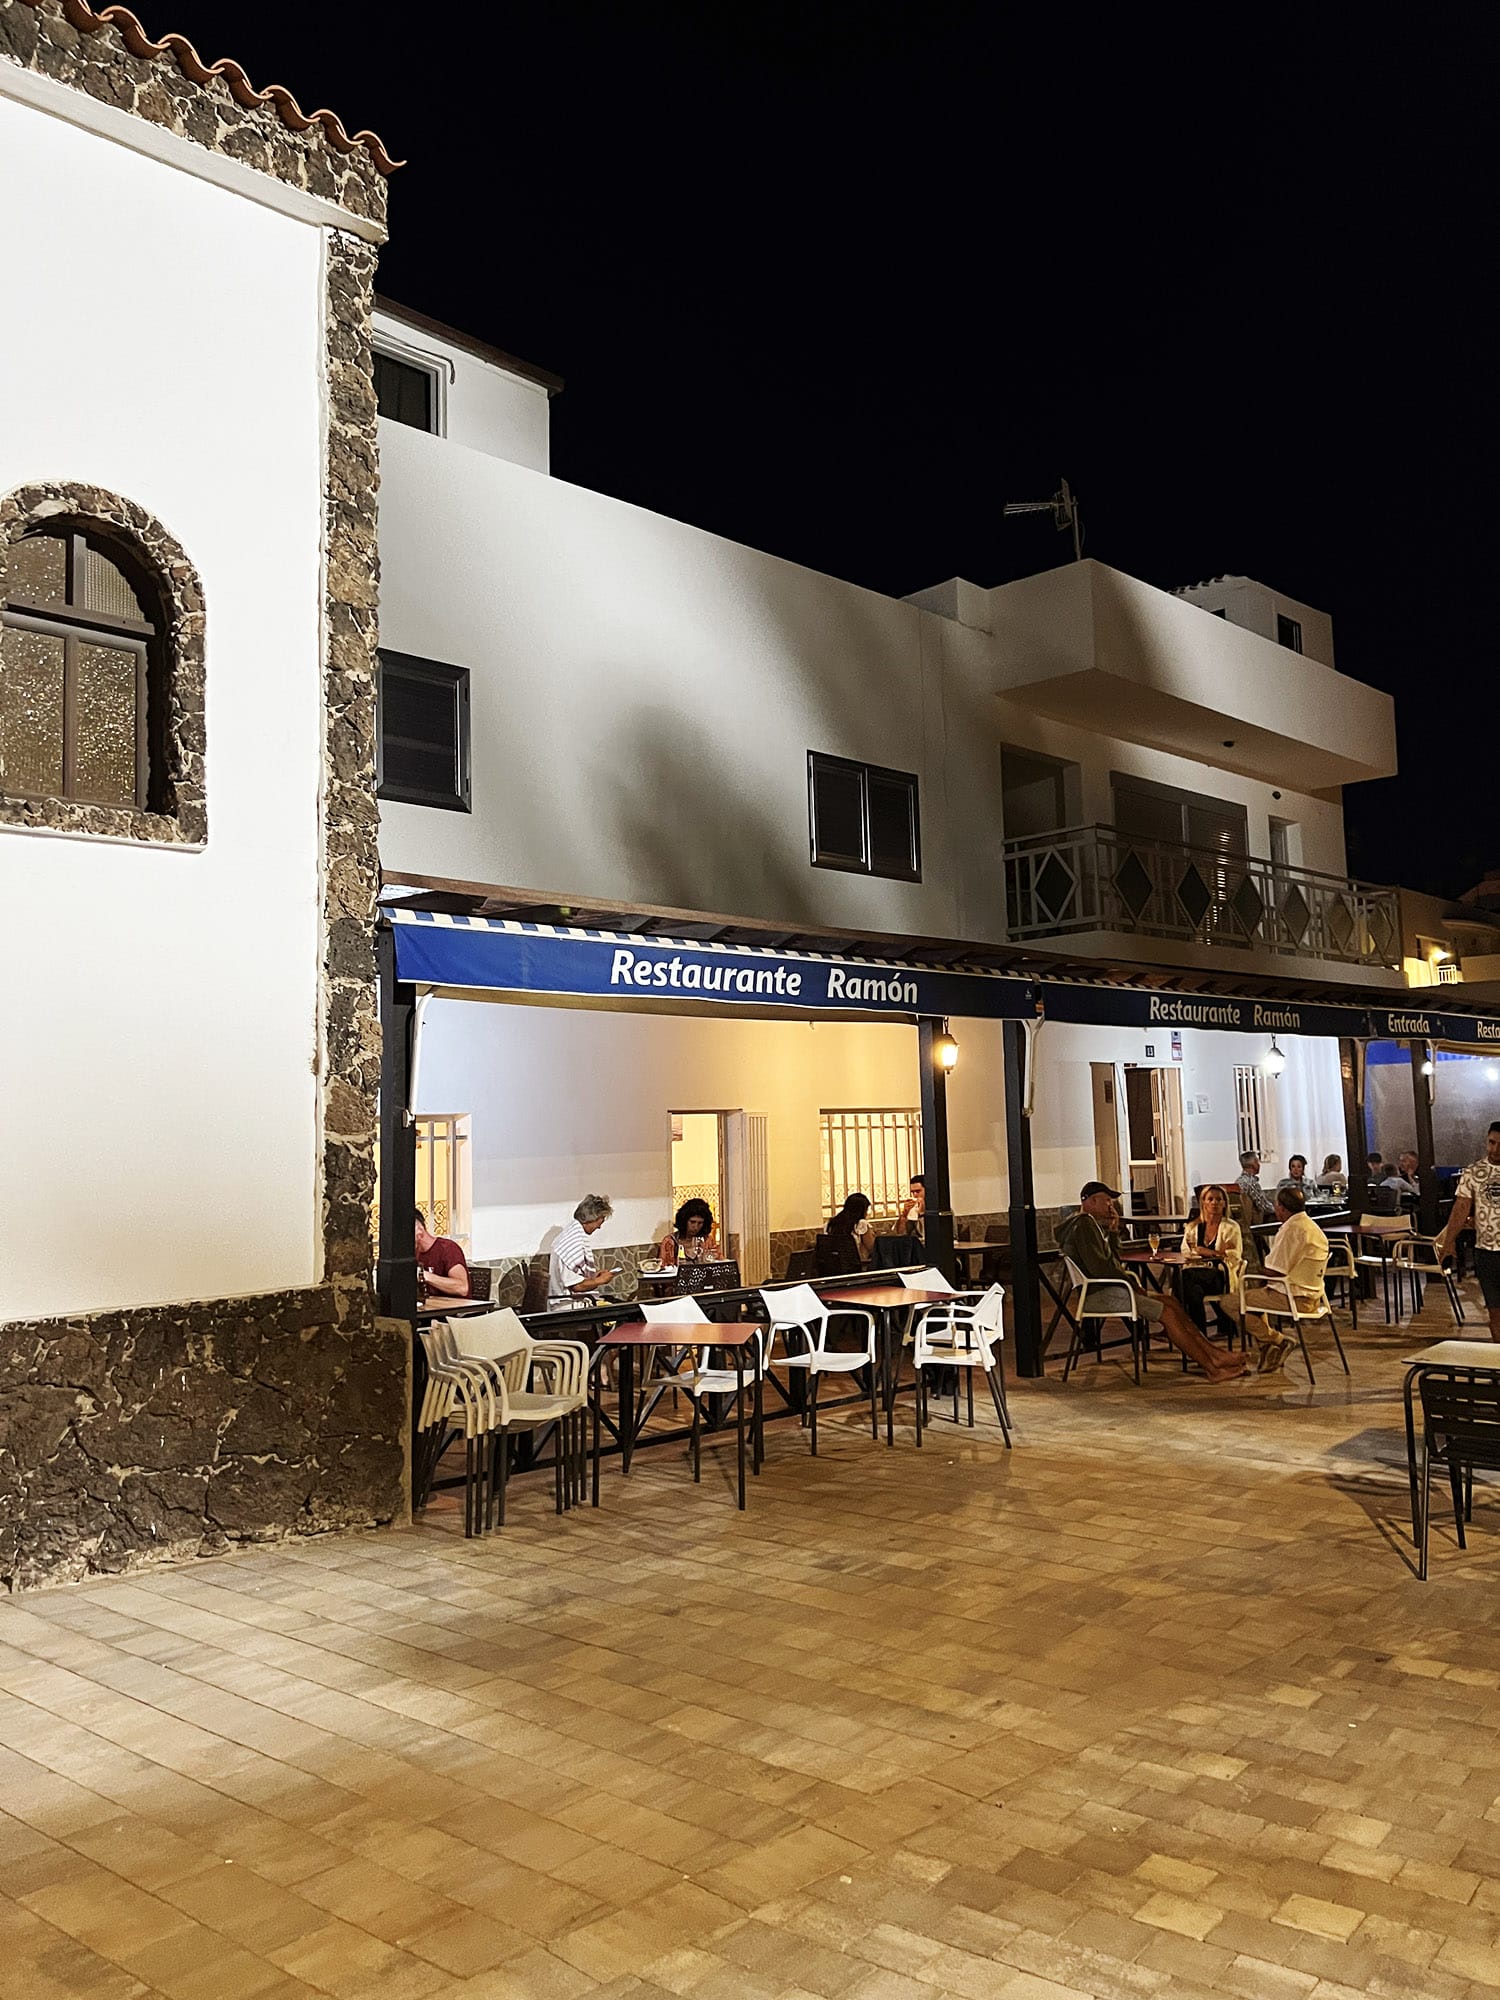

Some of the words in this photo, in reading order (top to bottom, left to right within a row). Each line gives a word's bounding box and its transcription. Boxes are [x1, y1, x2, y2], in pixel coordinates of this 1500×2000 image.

[610, 949, 802, 996] Restaurante
[827, 968, 918, 1004] Ramón
[1150, 996, 1241, 1025] Restaurante
[1254, 1004, 1300, 1028] Ramón
[1388, 1013, 1431, 1034] Entrada
